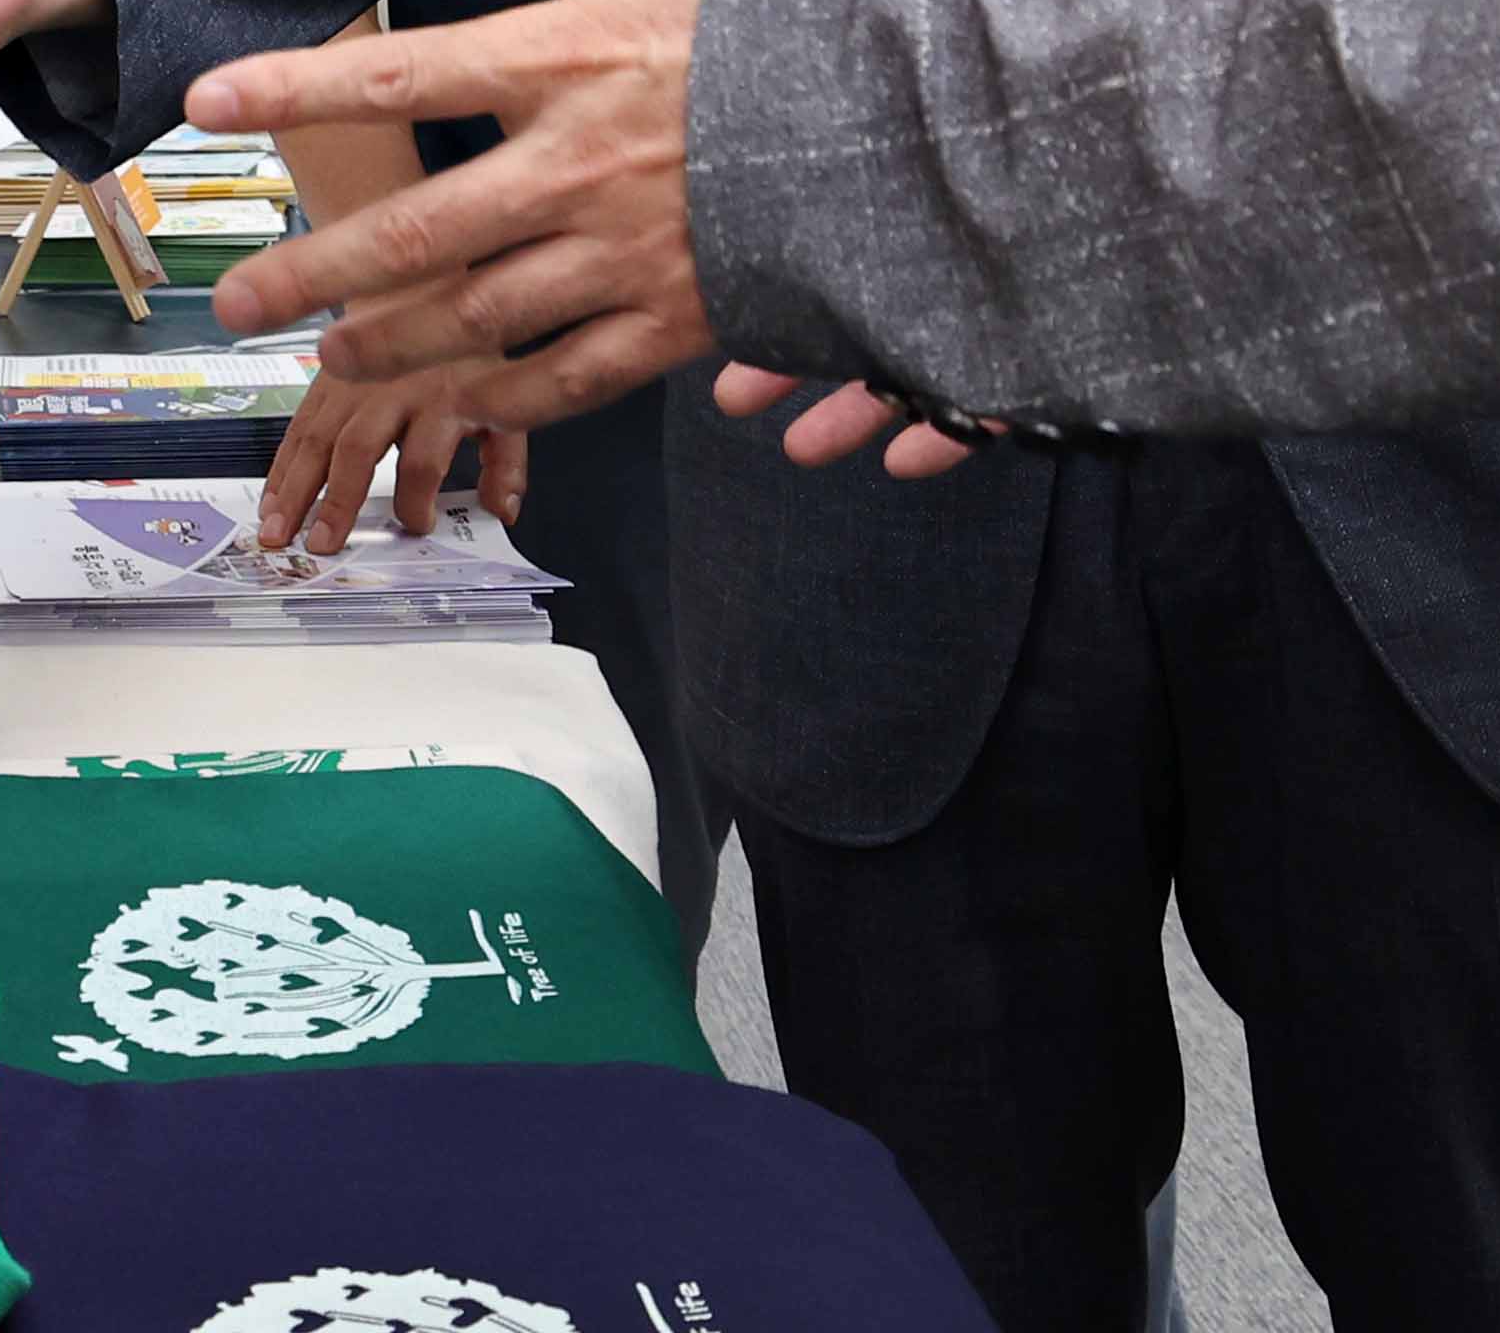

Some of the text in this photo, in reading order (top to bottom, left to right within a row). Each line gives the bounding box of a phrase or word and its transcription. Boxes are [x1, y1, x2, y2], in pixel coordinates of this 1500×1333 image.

[499, 912, 559, 1002] Tree of life
[673, 1281, 713, 1322] life
